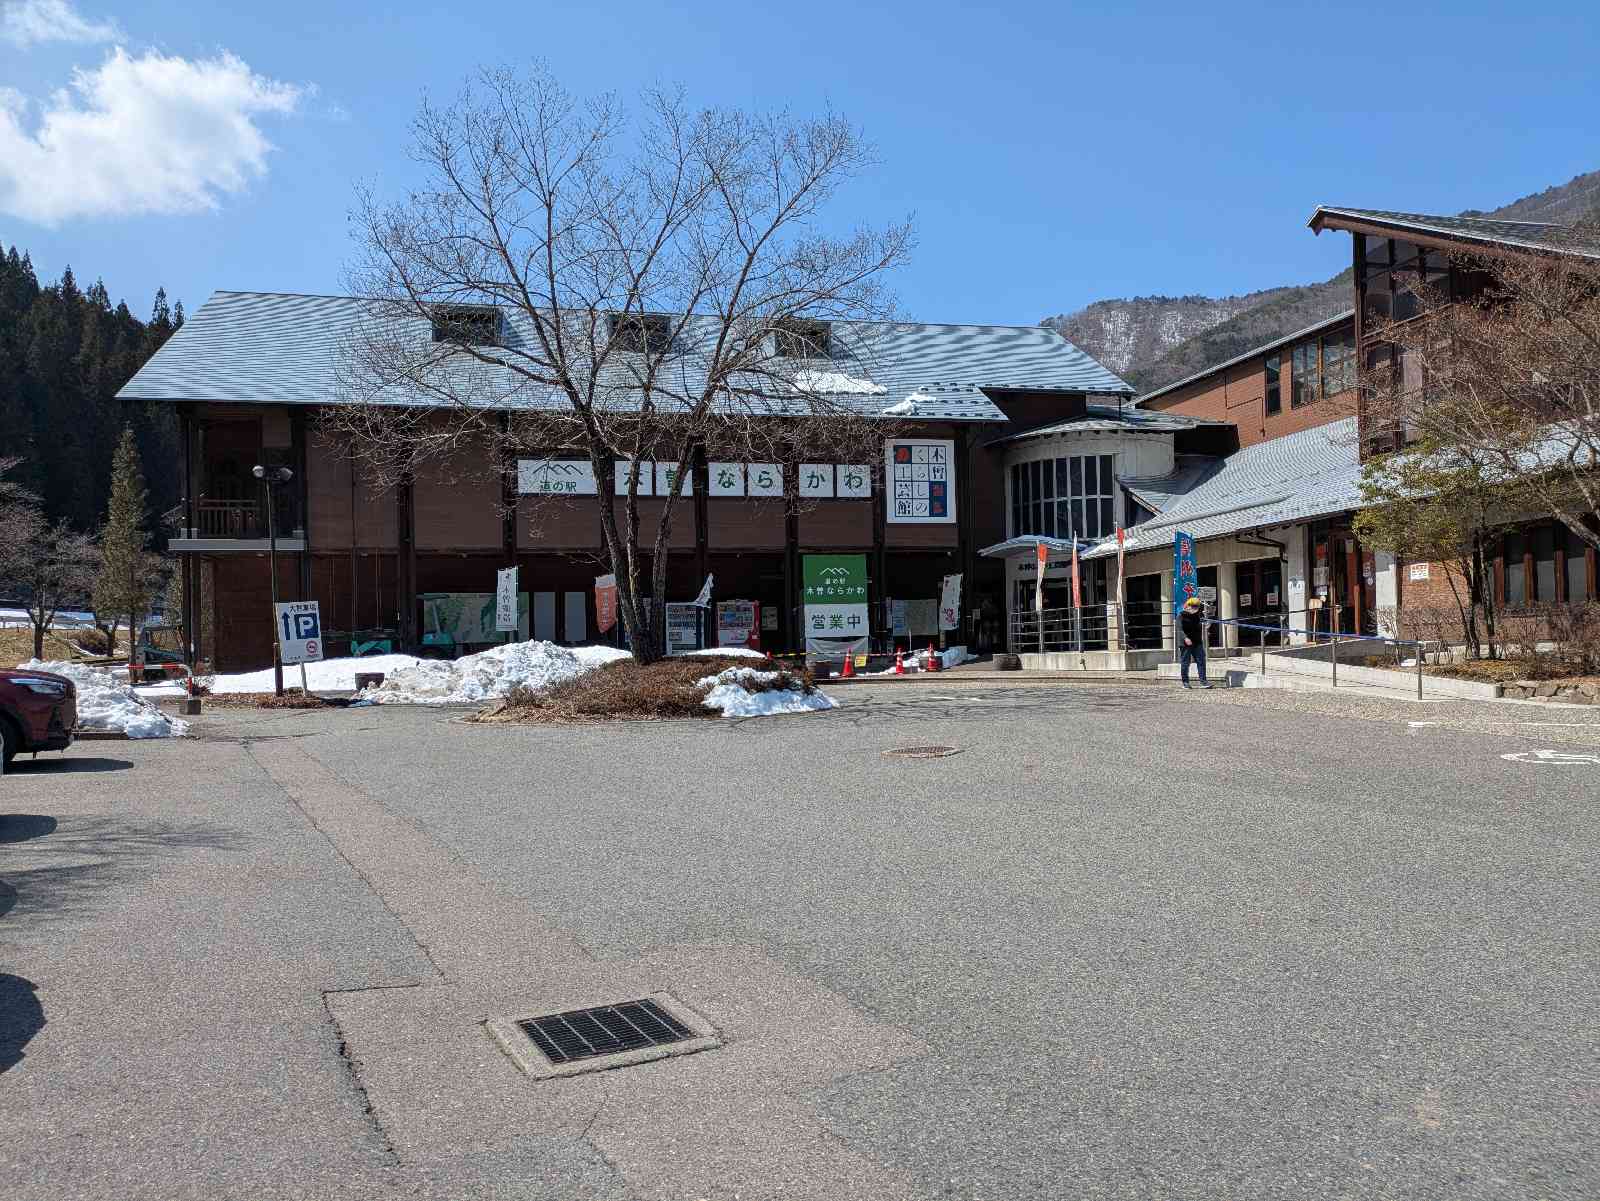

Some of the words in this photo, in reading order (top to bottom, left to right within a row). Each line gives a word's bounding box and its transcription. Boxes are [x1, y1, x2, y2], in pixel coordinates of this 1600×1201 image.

[540, 480, 577, 492] 道の駅
[806, 586, 865, 595] 木曽ならかわ
[298, 617, 314, 636] P
[811, 614, 861, 630] 営業中
